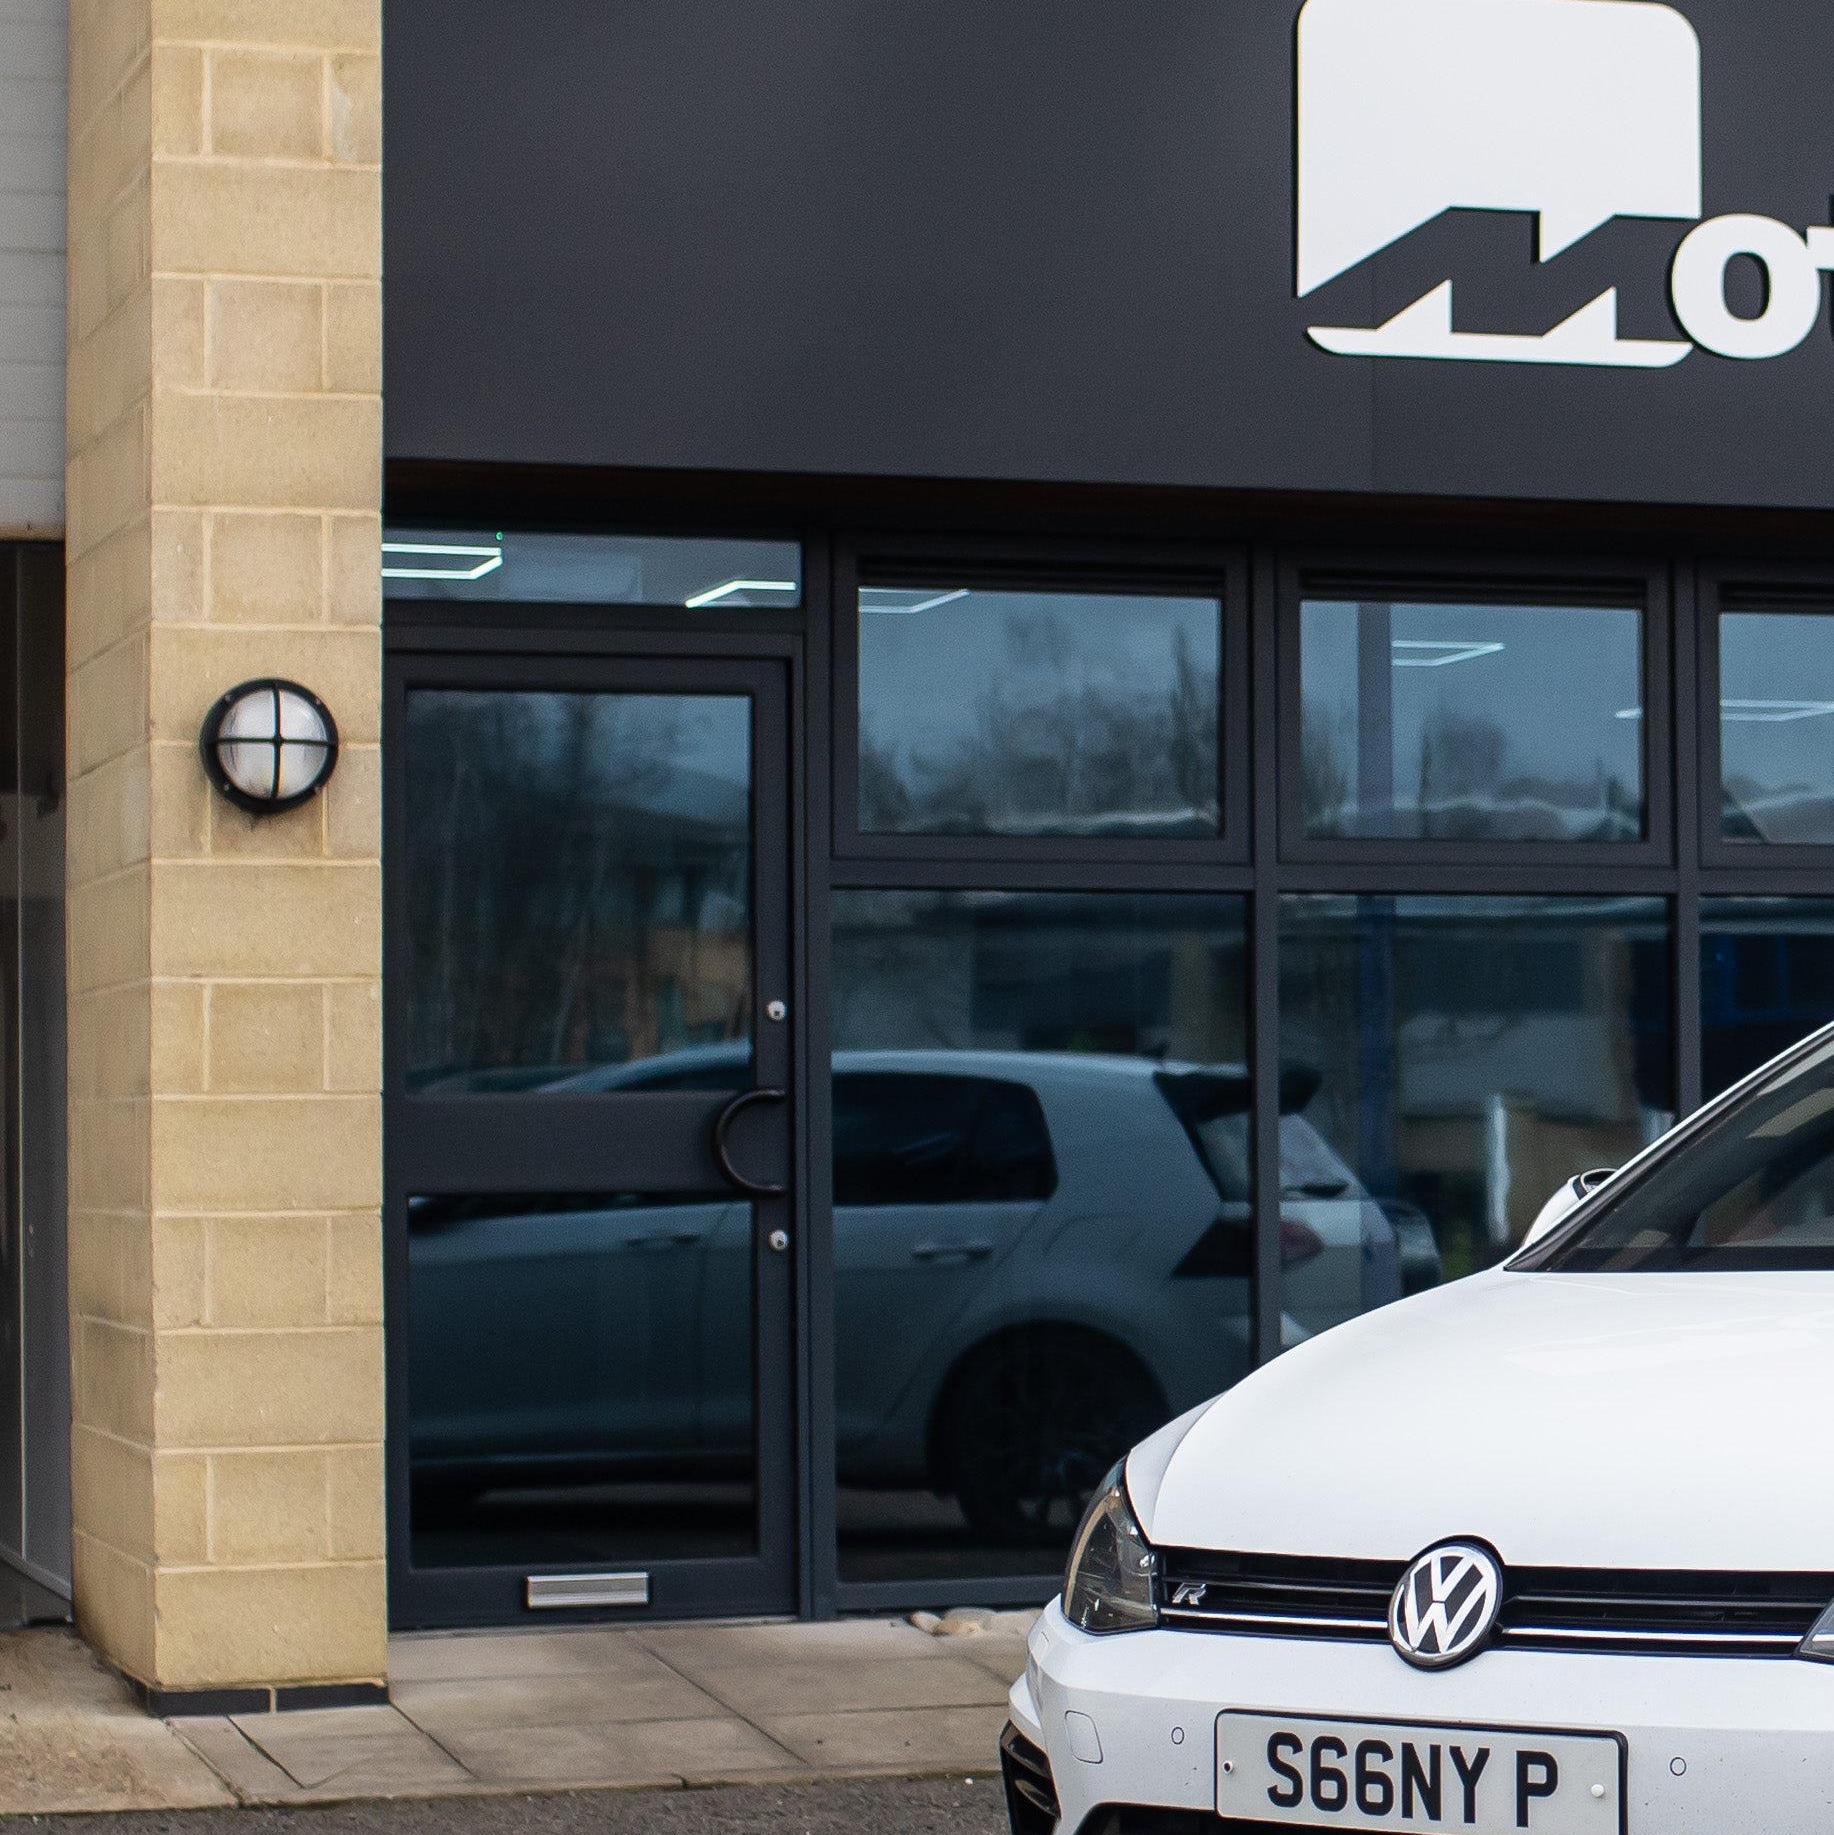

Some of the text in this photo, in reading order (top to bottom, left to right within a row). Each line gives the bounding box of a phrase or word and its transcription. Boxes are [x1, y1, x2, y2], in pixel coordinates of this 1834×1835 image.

[1172, 1582, 1206, 1605] R
[1396, 1547, 1495, 1655] VW
[1267, 1731, 1558, 1828] S66NY P
